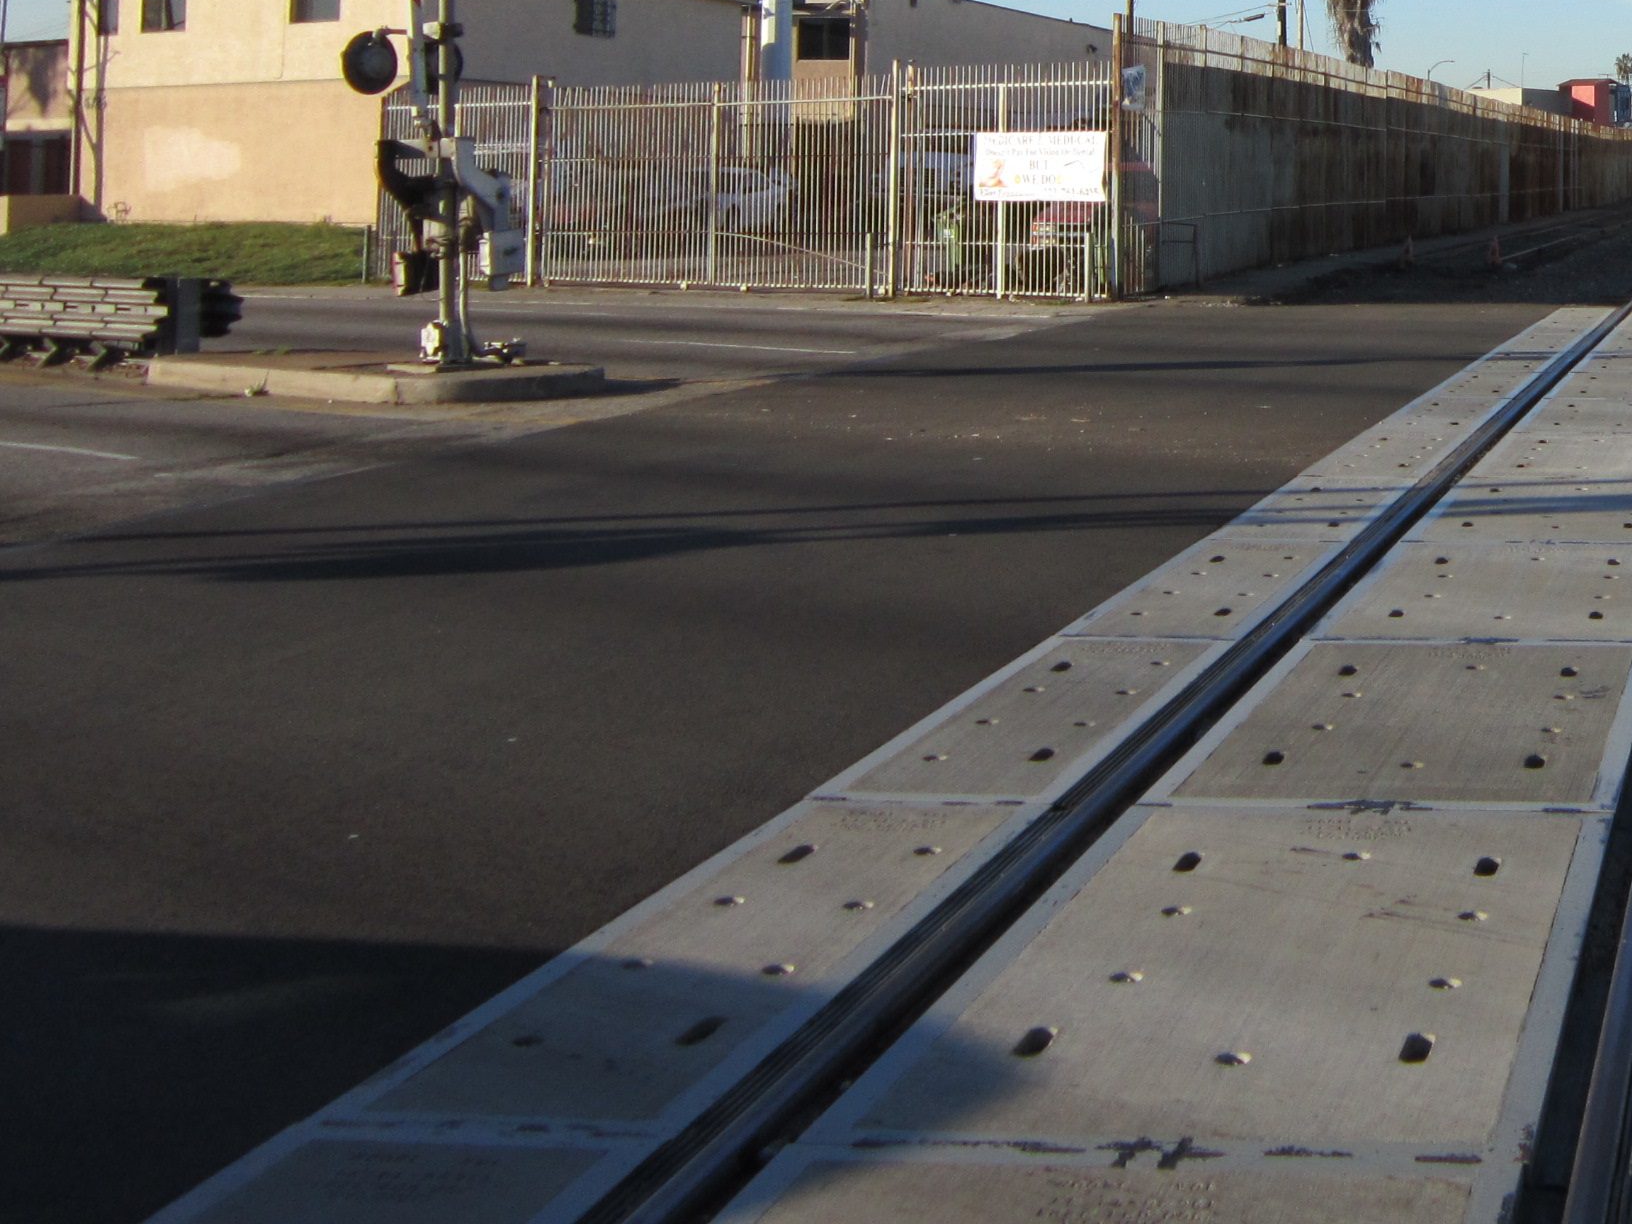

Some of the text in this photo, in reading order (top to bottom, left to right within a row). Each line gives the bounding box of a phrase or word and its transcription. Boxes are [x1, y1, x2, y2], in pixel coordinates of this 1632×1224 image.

[1029, 159, 1048, 170] BUT
[1021, 174, 1057, 184] WE DO
